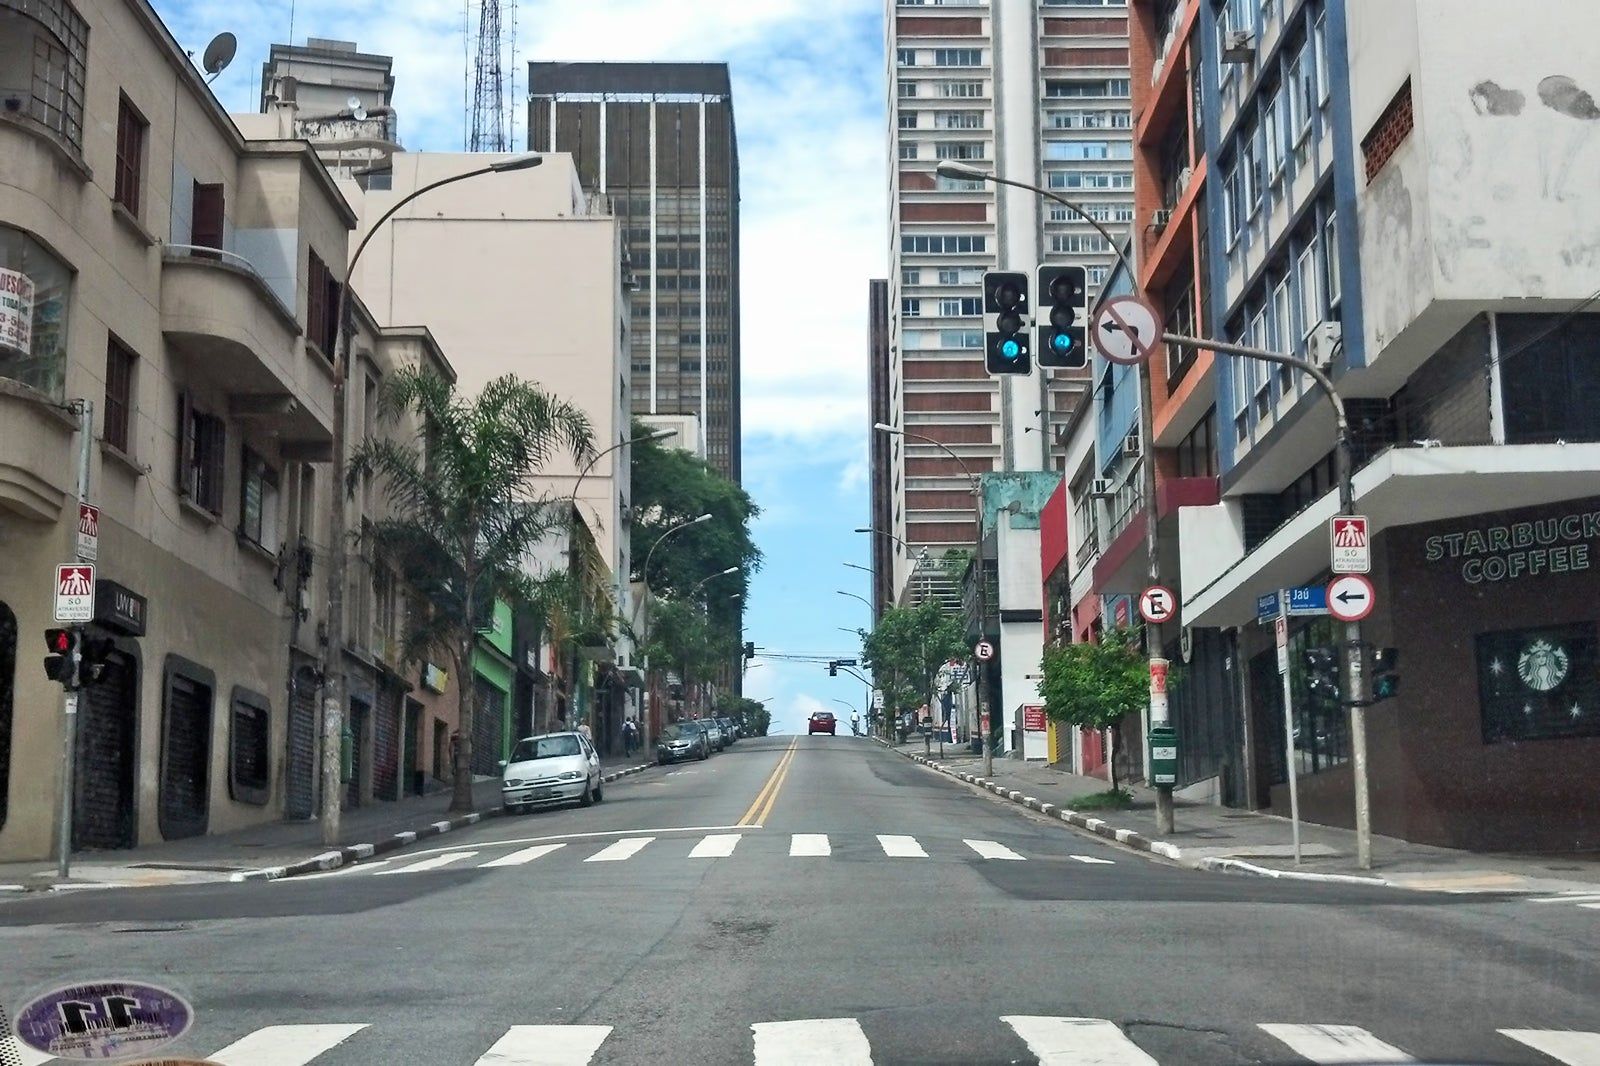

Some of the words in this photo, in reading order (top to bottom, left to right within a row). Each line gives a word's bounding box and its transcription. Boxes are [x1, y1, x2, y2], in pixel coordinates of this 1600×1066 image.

[1462, 544, 1590, 584] COFFEE
[68, 596, 81, 605] SÓ
[1294, 588, 1309, 600] Jaú
[1150, 593, 1164, 614] E
